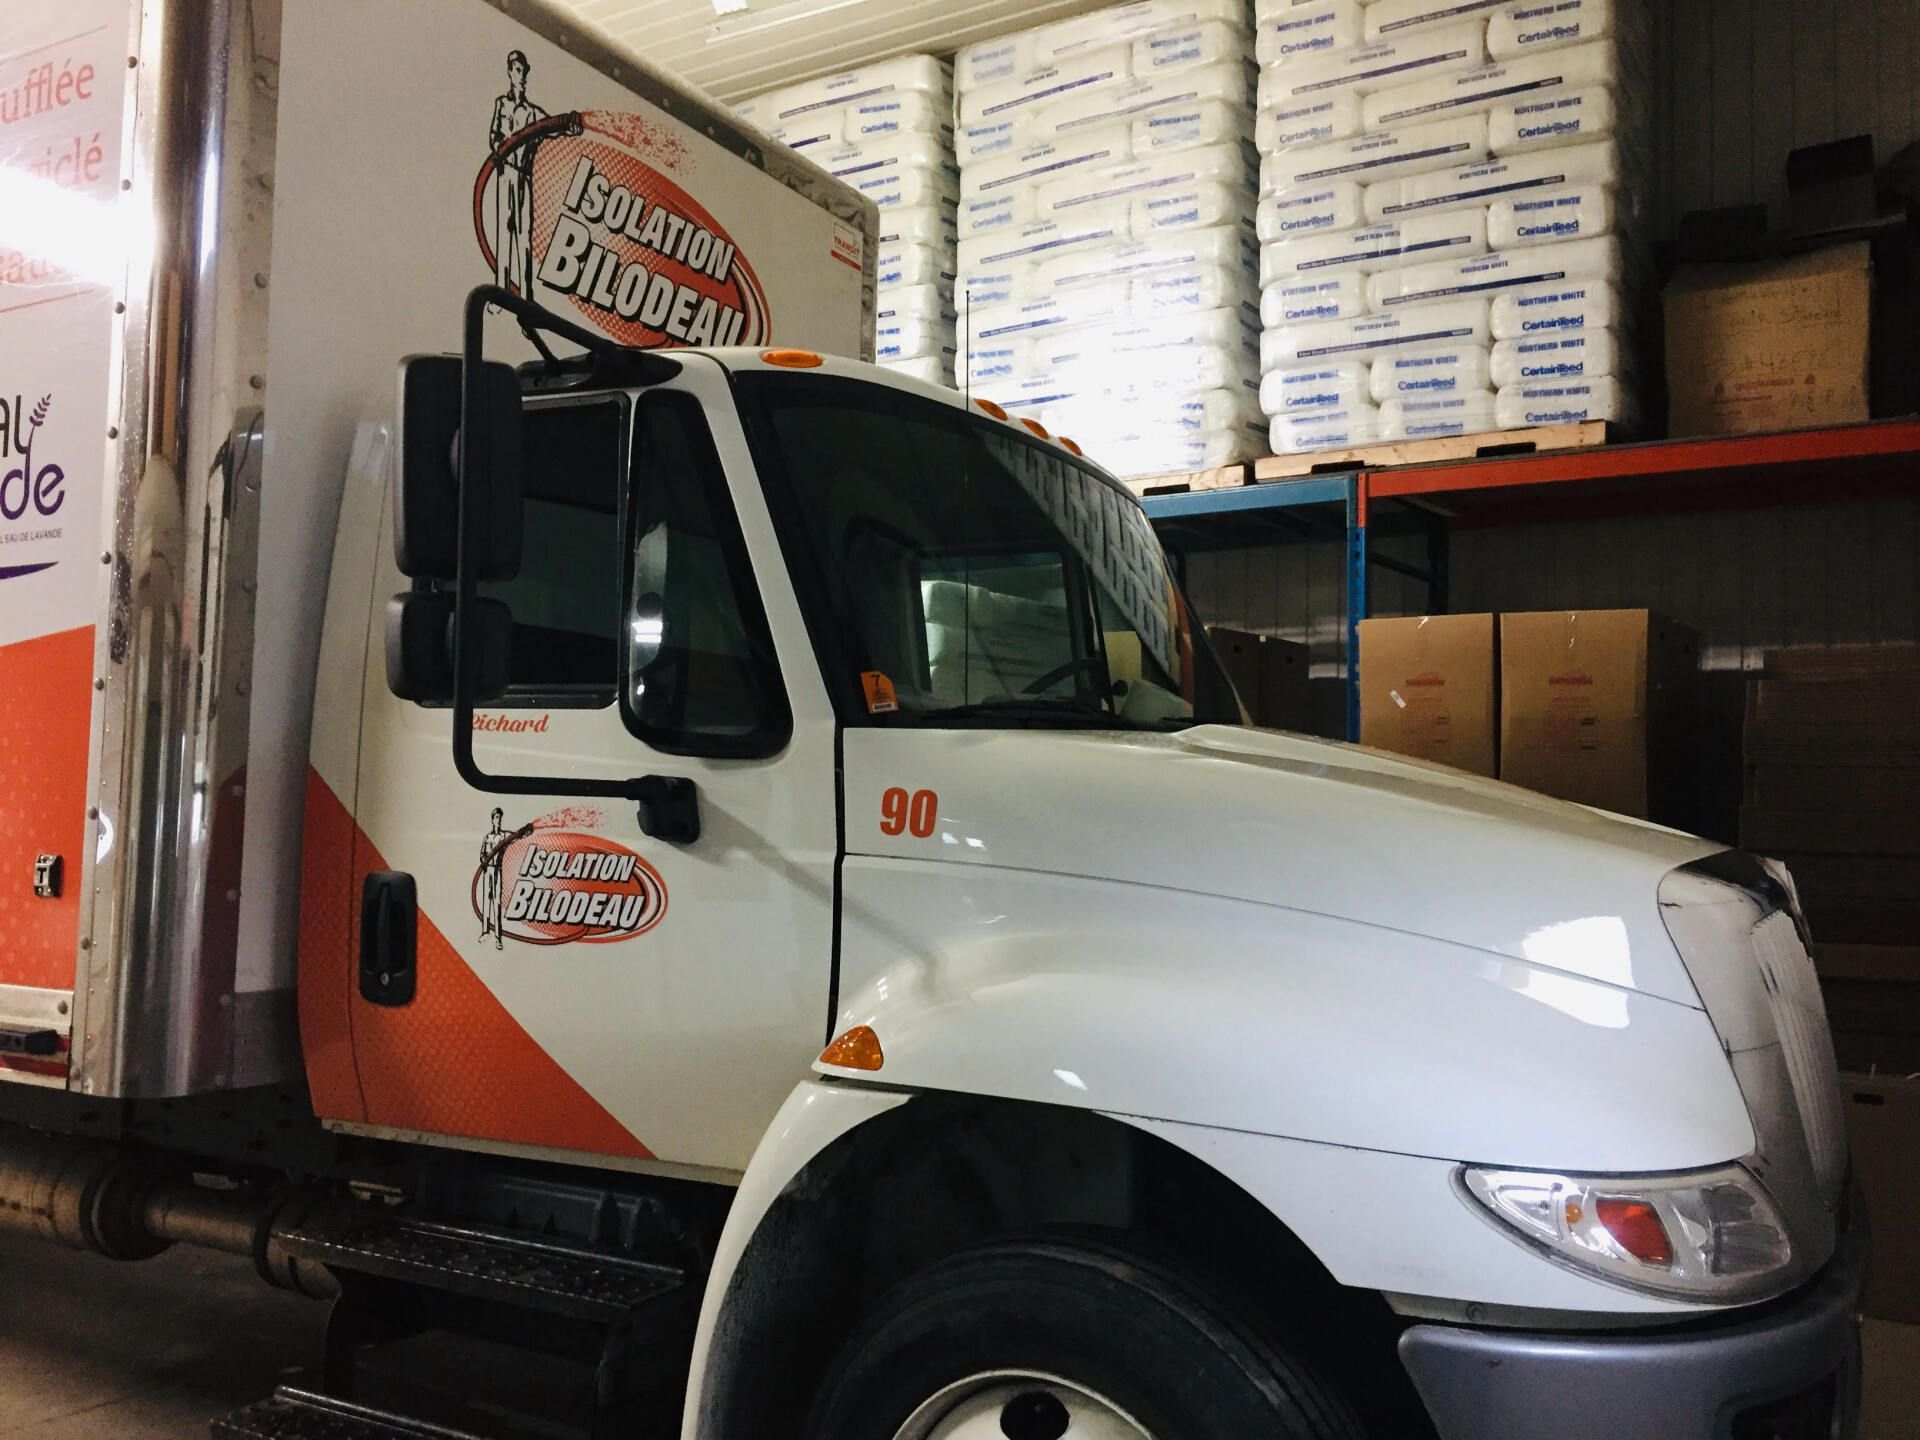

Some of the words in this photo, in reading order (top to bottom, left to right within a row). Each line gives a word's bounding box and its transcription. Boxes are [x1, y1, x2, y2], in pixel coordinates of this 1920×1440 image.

[1518, 119, 1580, 138] CertainTeed
[562, 153, 736, 284] ISOLATION
[1281, 213, 1335, 231] CertainTeed
[1517, 219, 1579, 237] CertainTeed
[536, 212, 746, 346] BILODEAU
[1518, 293, 1559, 307] NORTHERN
[1561, 290, 1585, 301] WHITE
[1285, 304, 1339, 319] CertainTeed
[1522, 314, 1584, 331] CertainTeed
[1517, 341, 1558, 353] NORTHERN
[1561, 338, 1585, 348] WHITE
[1521, 362, 1584, 377] CertainTeed
[1398, 376, 1455, 390] CertainTeed
[1286, 393, 1340, 406] CertainTeed
[1522, 387, 1564, 399] NORTHERN
[1566, 386, 1590, 396] WHITE
[1525, 409, 1588, 423] CertainTeed
[30, 527, 63, 541] LAVANDE
[879, 786, 939, 839] 90
[518, 844, 637, 883] ISOLATION
[503, 879, 646, 930] BILODEAU
